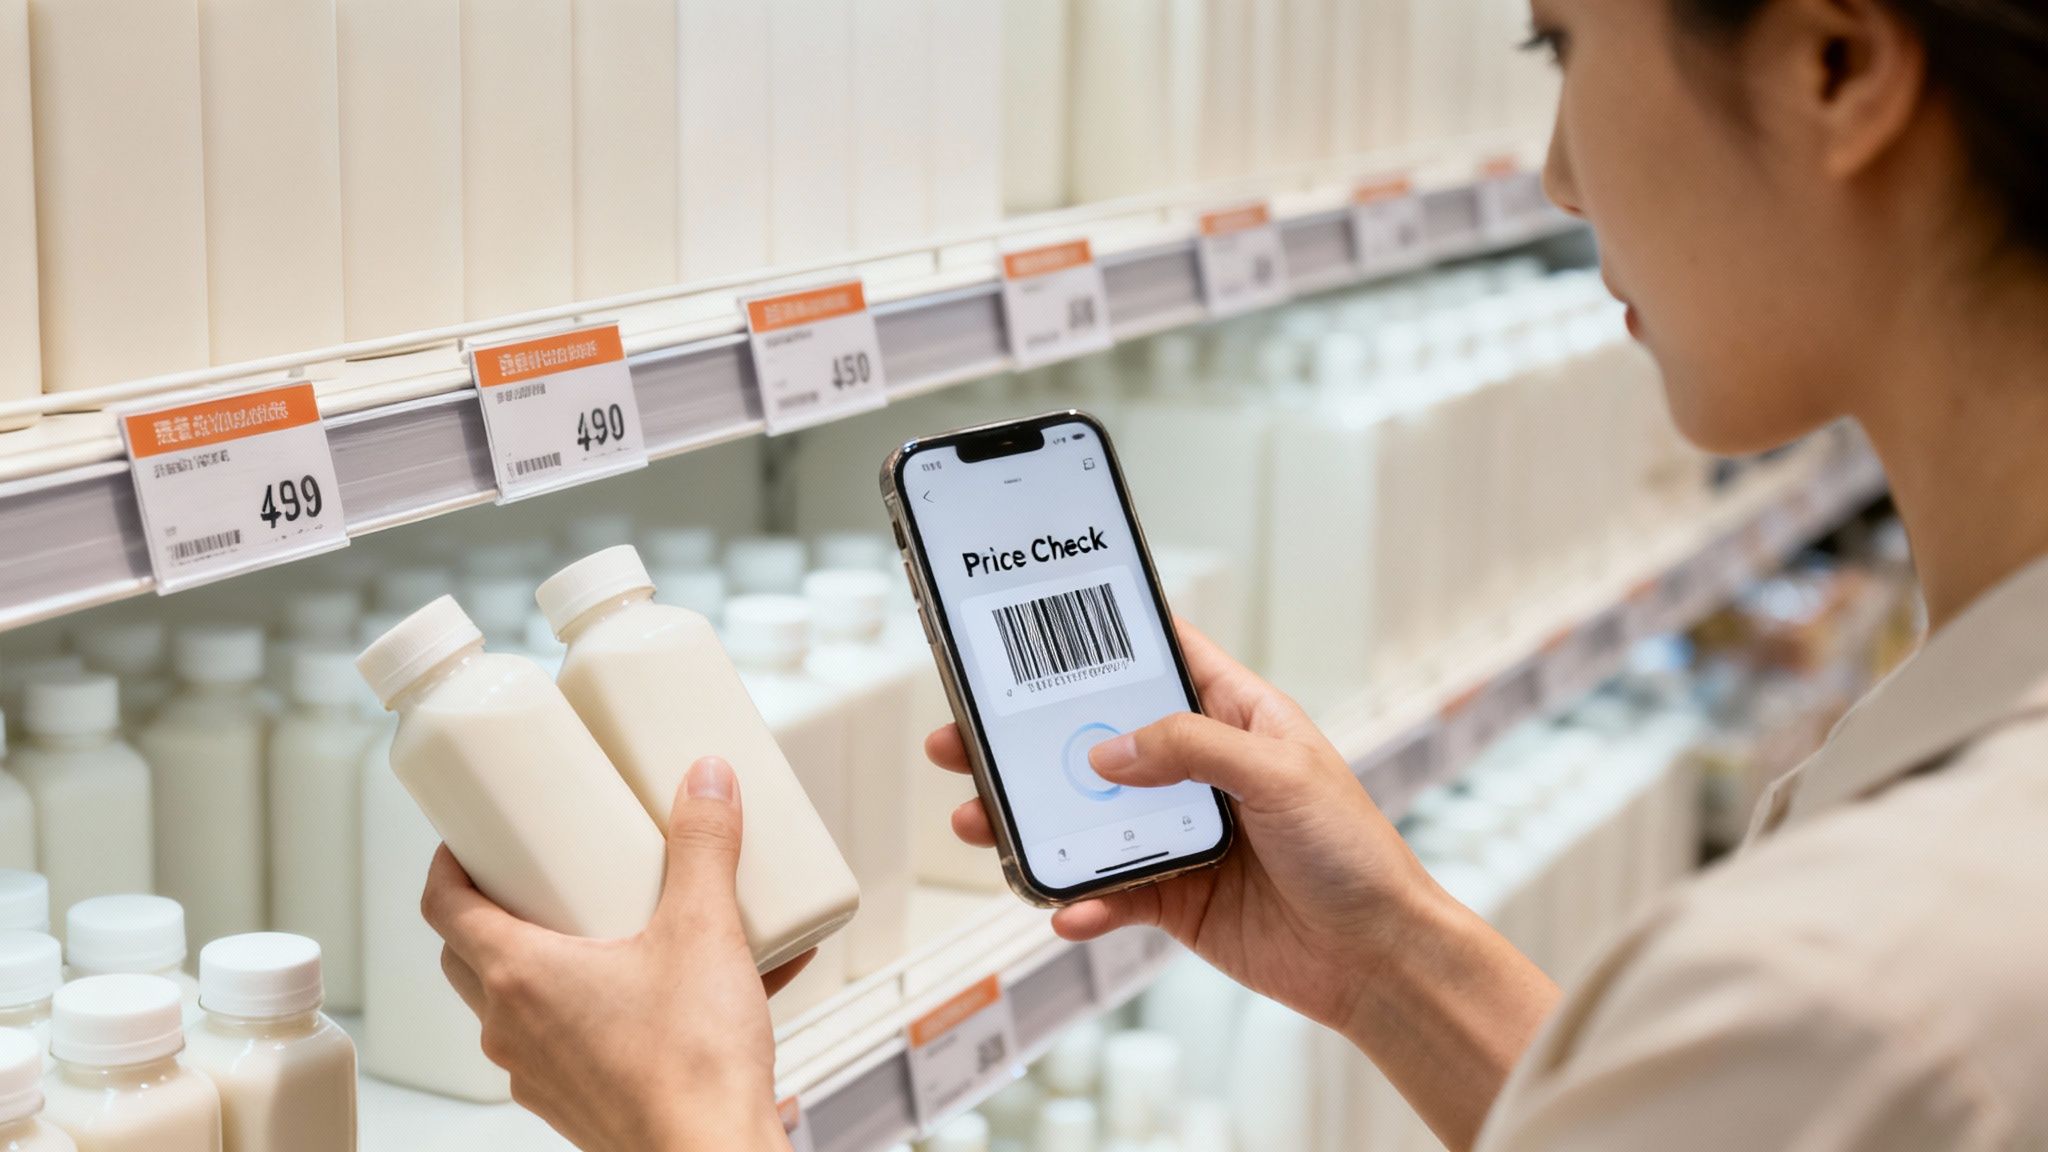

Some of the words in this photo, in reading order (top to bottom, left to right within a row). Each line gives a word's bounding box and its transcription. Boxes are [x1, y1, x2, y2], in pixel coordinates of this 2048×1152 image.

[832, 351, 871, 390] 450
[577, 403, 626, 452] 490
[260, 474, 323, 529] 499
[962, 546, 1027, 578] Price
[1031, 526, 1108, 563] Check
